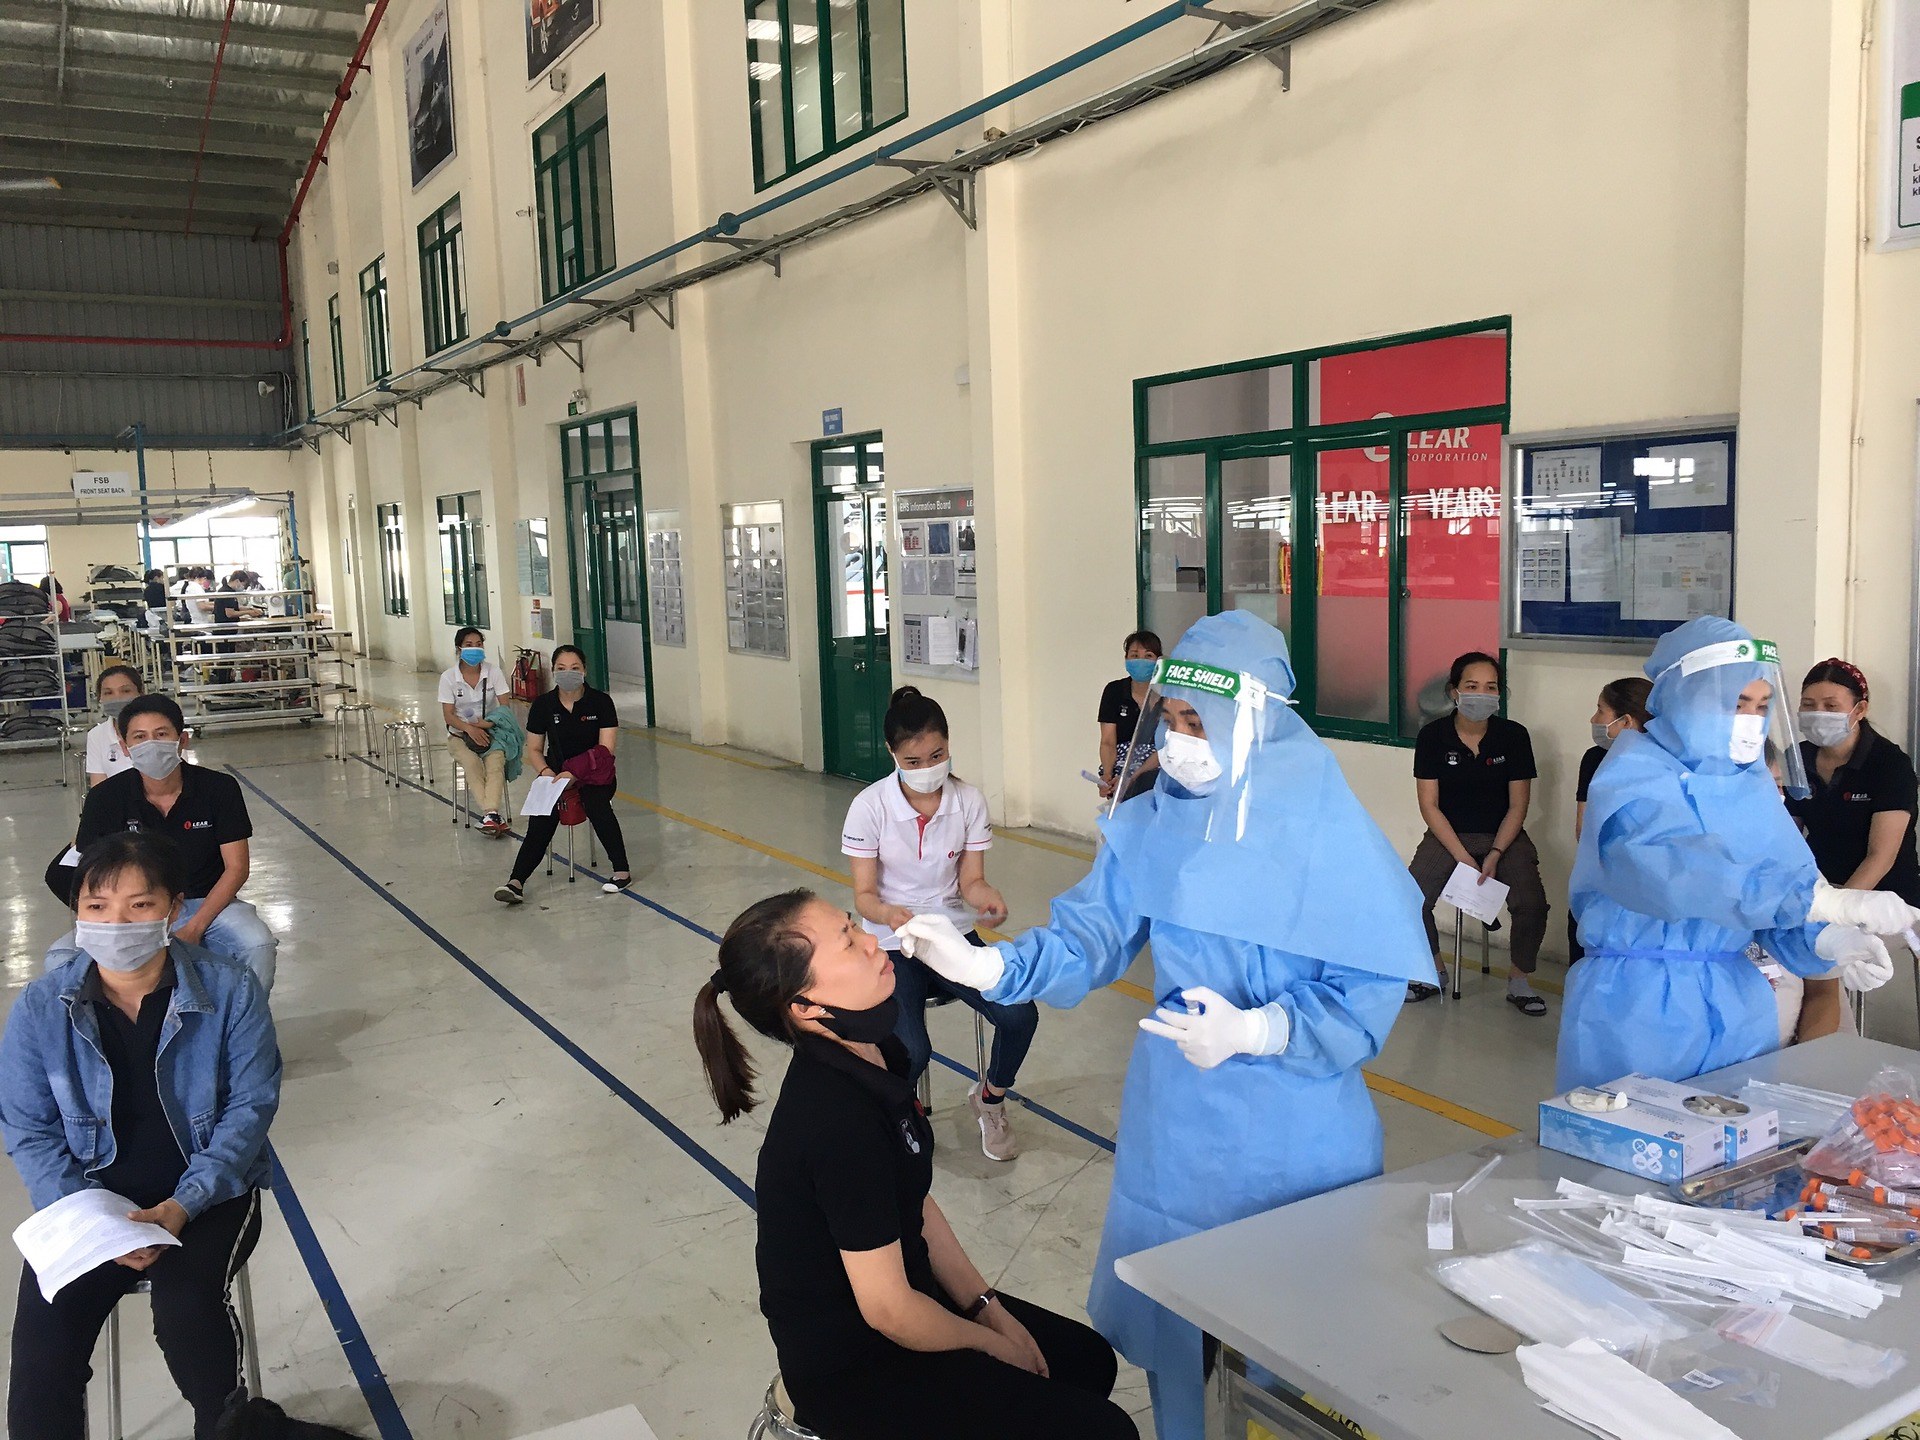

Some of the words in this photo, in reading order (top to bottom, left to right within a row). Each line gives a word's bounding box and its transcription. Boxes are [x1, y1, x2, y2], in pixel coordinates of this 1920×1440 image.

[1407, 426, 1470, 449] LEAR
[1407, 453, 1488, 462] ORPORATION
[93, 476, 110, 484] FSB
[936, 499, 952, 510] Board
[1319, 490, 1377, 524] LEAR
[1428, 486, 1495, 519] YEARS
[1165, 664, 1194, 680] FACE
[1191, 668, 1235, 690] SHIELD
[1197, 683, 1225, 694] Protection
